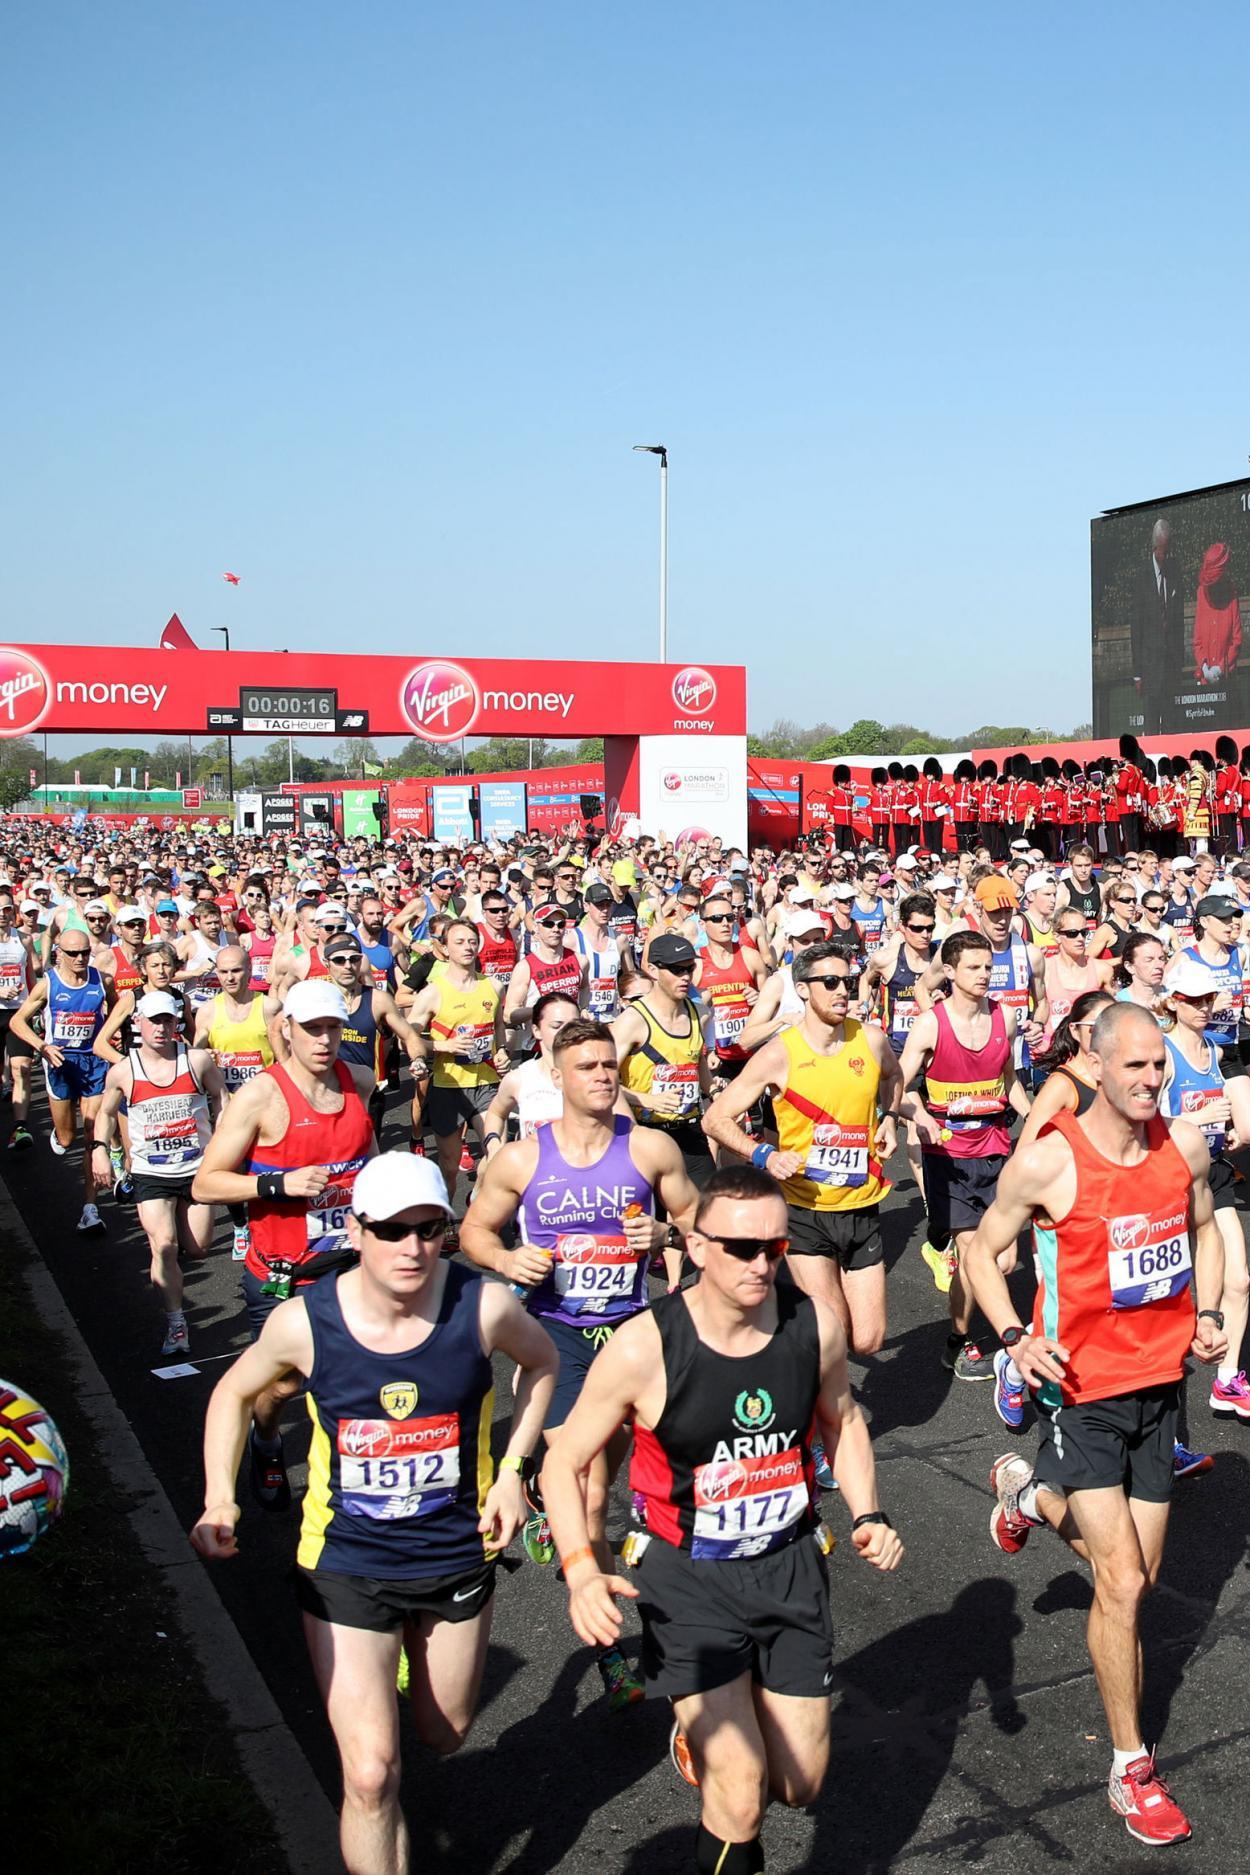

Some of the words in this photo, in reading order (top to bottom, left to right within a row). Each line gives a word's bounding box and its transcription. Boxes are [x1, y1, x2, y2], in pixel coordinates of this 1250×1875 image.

[57, 682, 167, 711] money
[677, 675, 712, 706] Virgin
[248, 696, 330, 714] 00:00:16
[410, 672, 471, 727] Virgin
[483, 688, 575, 718] money
[674, 719, 714, 732] money
[265, 798, 294, 807] APOGEE
[807, 803, 827, 811] LON
[265, 813, 294, 823] APOGEE
[812, 811, 830, 819] PRI
[536, 963, 576, 980] BRIAN
[540, 975, 579, 992] SPERRIN
[1003, 994, 1027, 1003] money
[730, 1006, 749, 1014] money
[60, 1025, 90, 1037] 1875
[719, 1019, 746, 1034] 1901
[223, 1066, 257, 1080] 1986
[142, 1097, 194, 1113] GATESHEAD
[146, 1108, 193, 1123] HARRIERS
[153, 1135, 193, 1151] 1895
[842, 1131, 867, 1142] money
[818, 1147, 860, 1168] 1941
[825, 1173, 849, 1187] NB
[536, 1186, 636, 1214] CALNE
[539, 1208, 596, 1226] Running
[601, 1205, 626, 1218] Clu
[1151, 1211, 1187, 1233] money
[1123, 1238, 1183, 1279] 1688
[566, 1265, 626, 1290] 1924
[1140, 1278, 1172, 1304] NB
[578, 1297, 610, 1314] NB
[346, 1421, 389, 1456] Virgin
[395, 1423, 454, 1446] money
[712, 1429, 798, 1464] ARMY
[357, 1454, 445, 1489] 1512
[702, 1464, 746, 1500] Virgin
[750, 1461, 800, 1483] money
[378, 1494, 423, 1520] NB
[713, 1490, 793, 1532] 1177
[728, 1534, 773, 1559] NB
